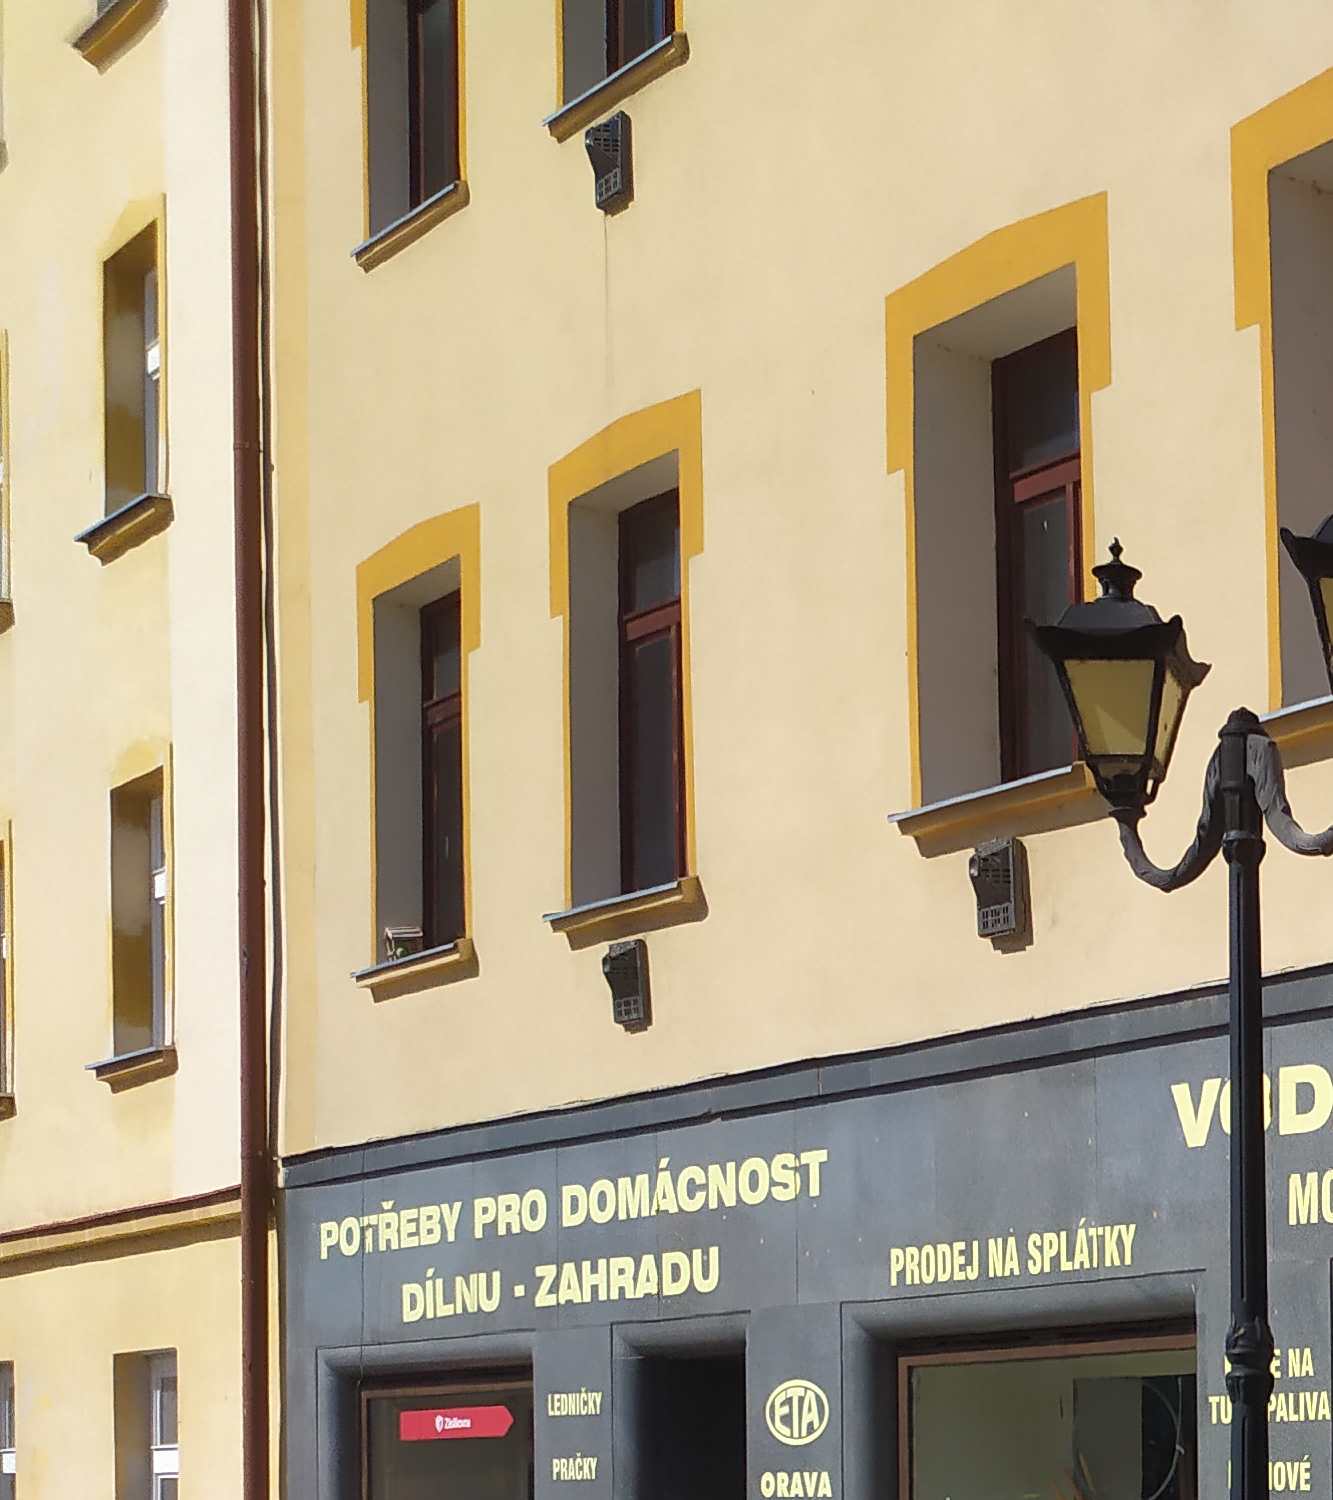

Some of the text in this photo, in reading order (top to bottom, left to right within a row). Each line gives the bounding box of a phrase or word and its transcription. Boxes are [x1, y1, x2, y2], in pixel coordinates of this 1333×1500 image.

[320, 1149, 828, 1260] POTŘEBY PRO DOMÁCNOST
[890, 1217, 1137, 1287] PRODEJ NA SPLÁTKY
[402, 1267, 501, 1323] DÍLNU
[534, 1245, 719, 1308] ZAHRADU
[1287, 1347, 1314, 1378] NA
[547, 1386, 603, 1417] LEDNIČKY
[552, 1453, 598, 1480] PRAČKY
[760, 1471, 833, 1498] ORAVA
